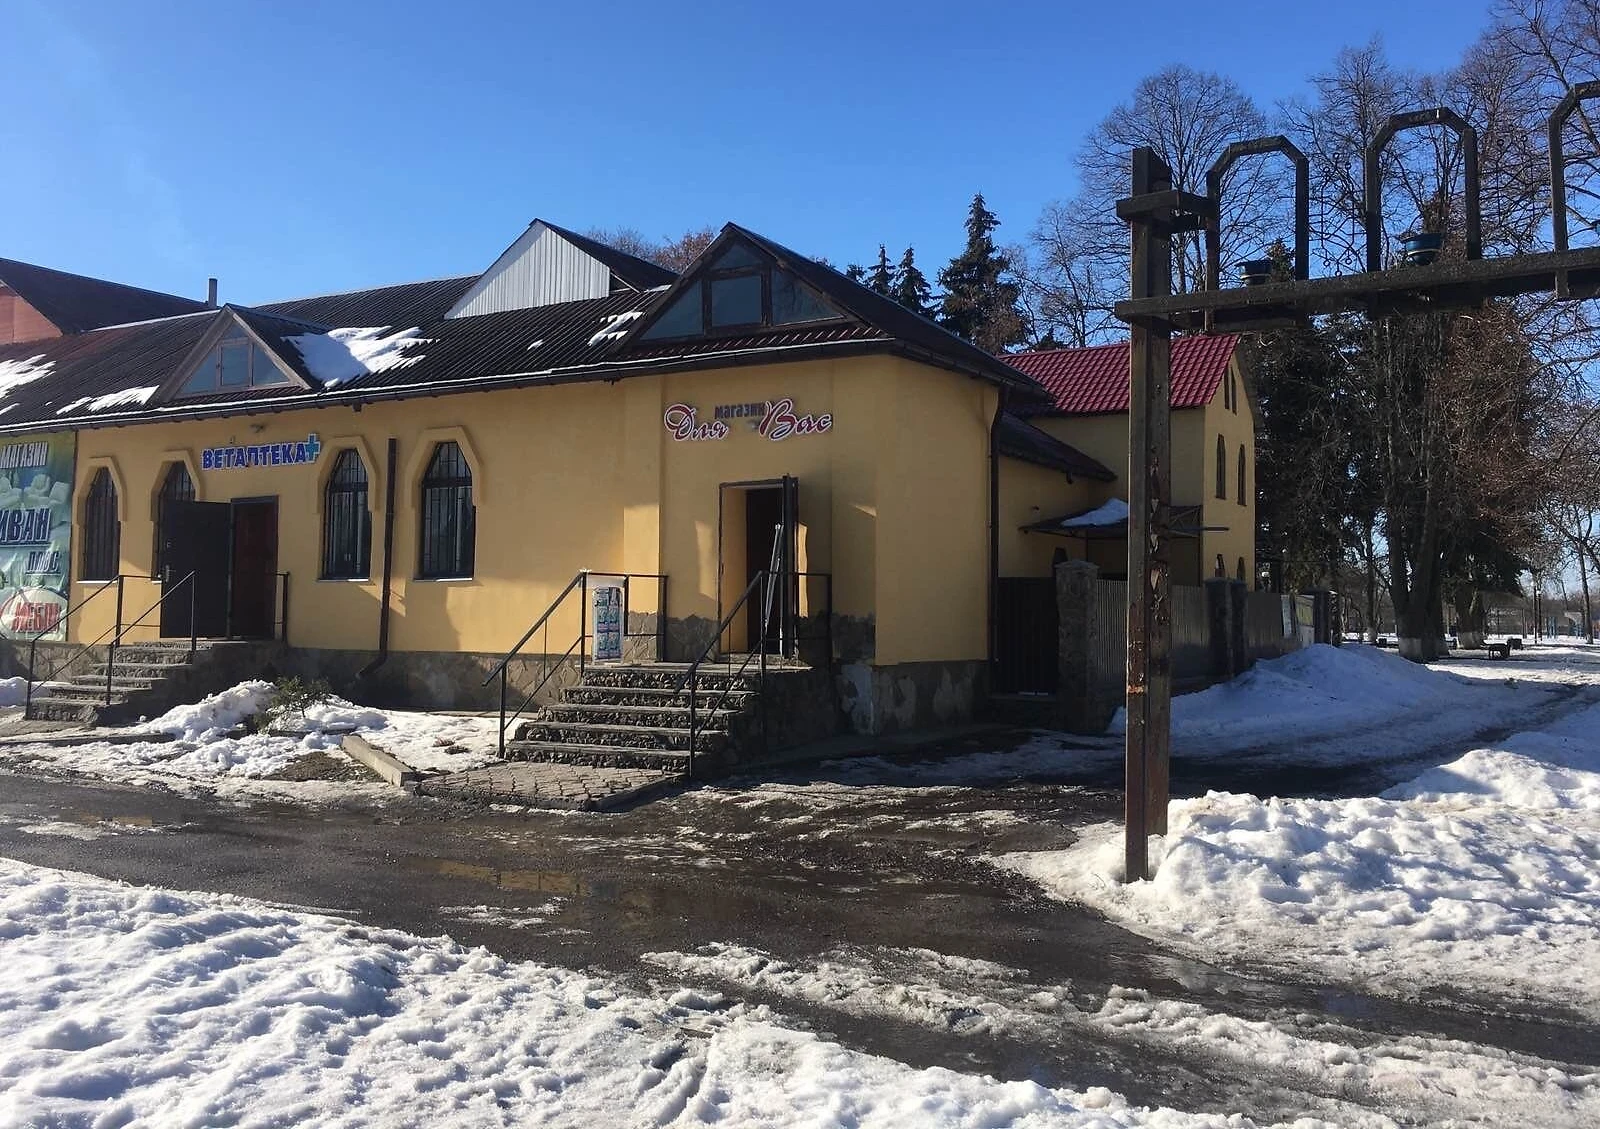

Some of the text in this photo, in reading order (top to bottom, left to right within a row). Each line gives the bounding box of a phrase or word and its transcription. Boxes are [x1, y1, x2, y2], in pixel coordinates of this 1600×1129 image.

[664, 399, 833, 441] Для Вас
[202, 441, 308, 470] ВЕТАПТЕКА
